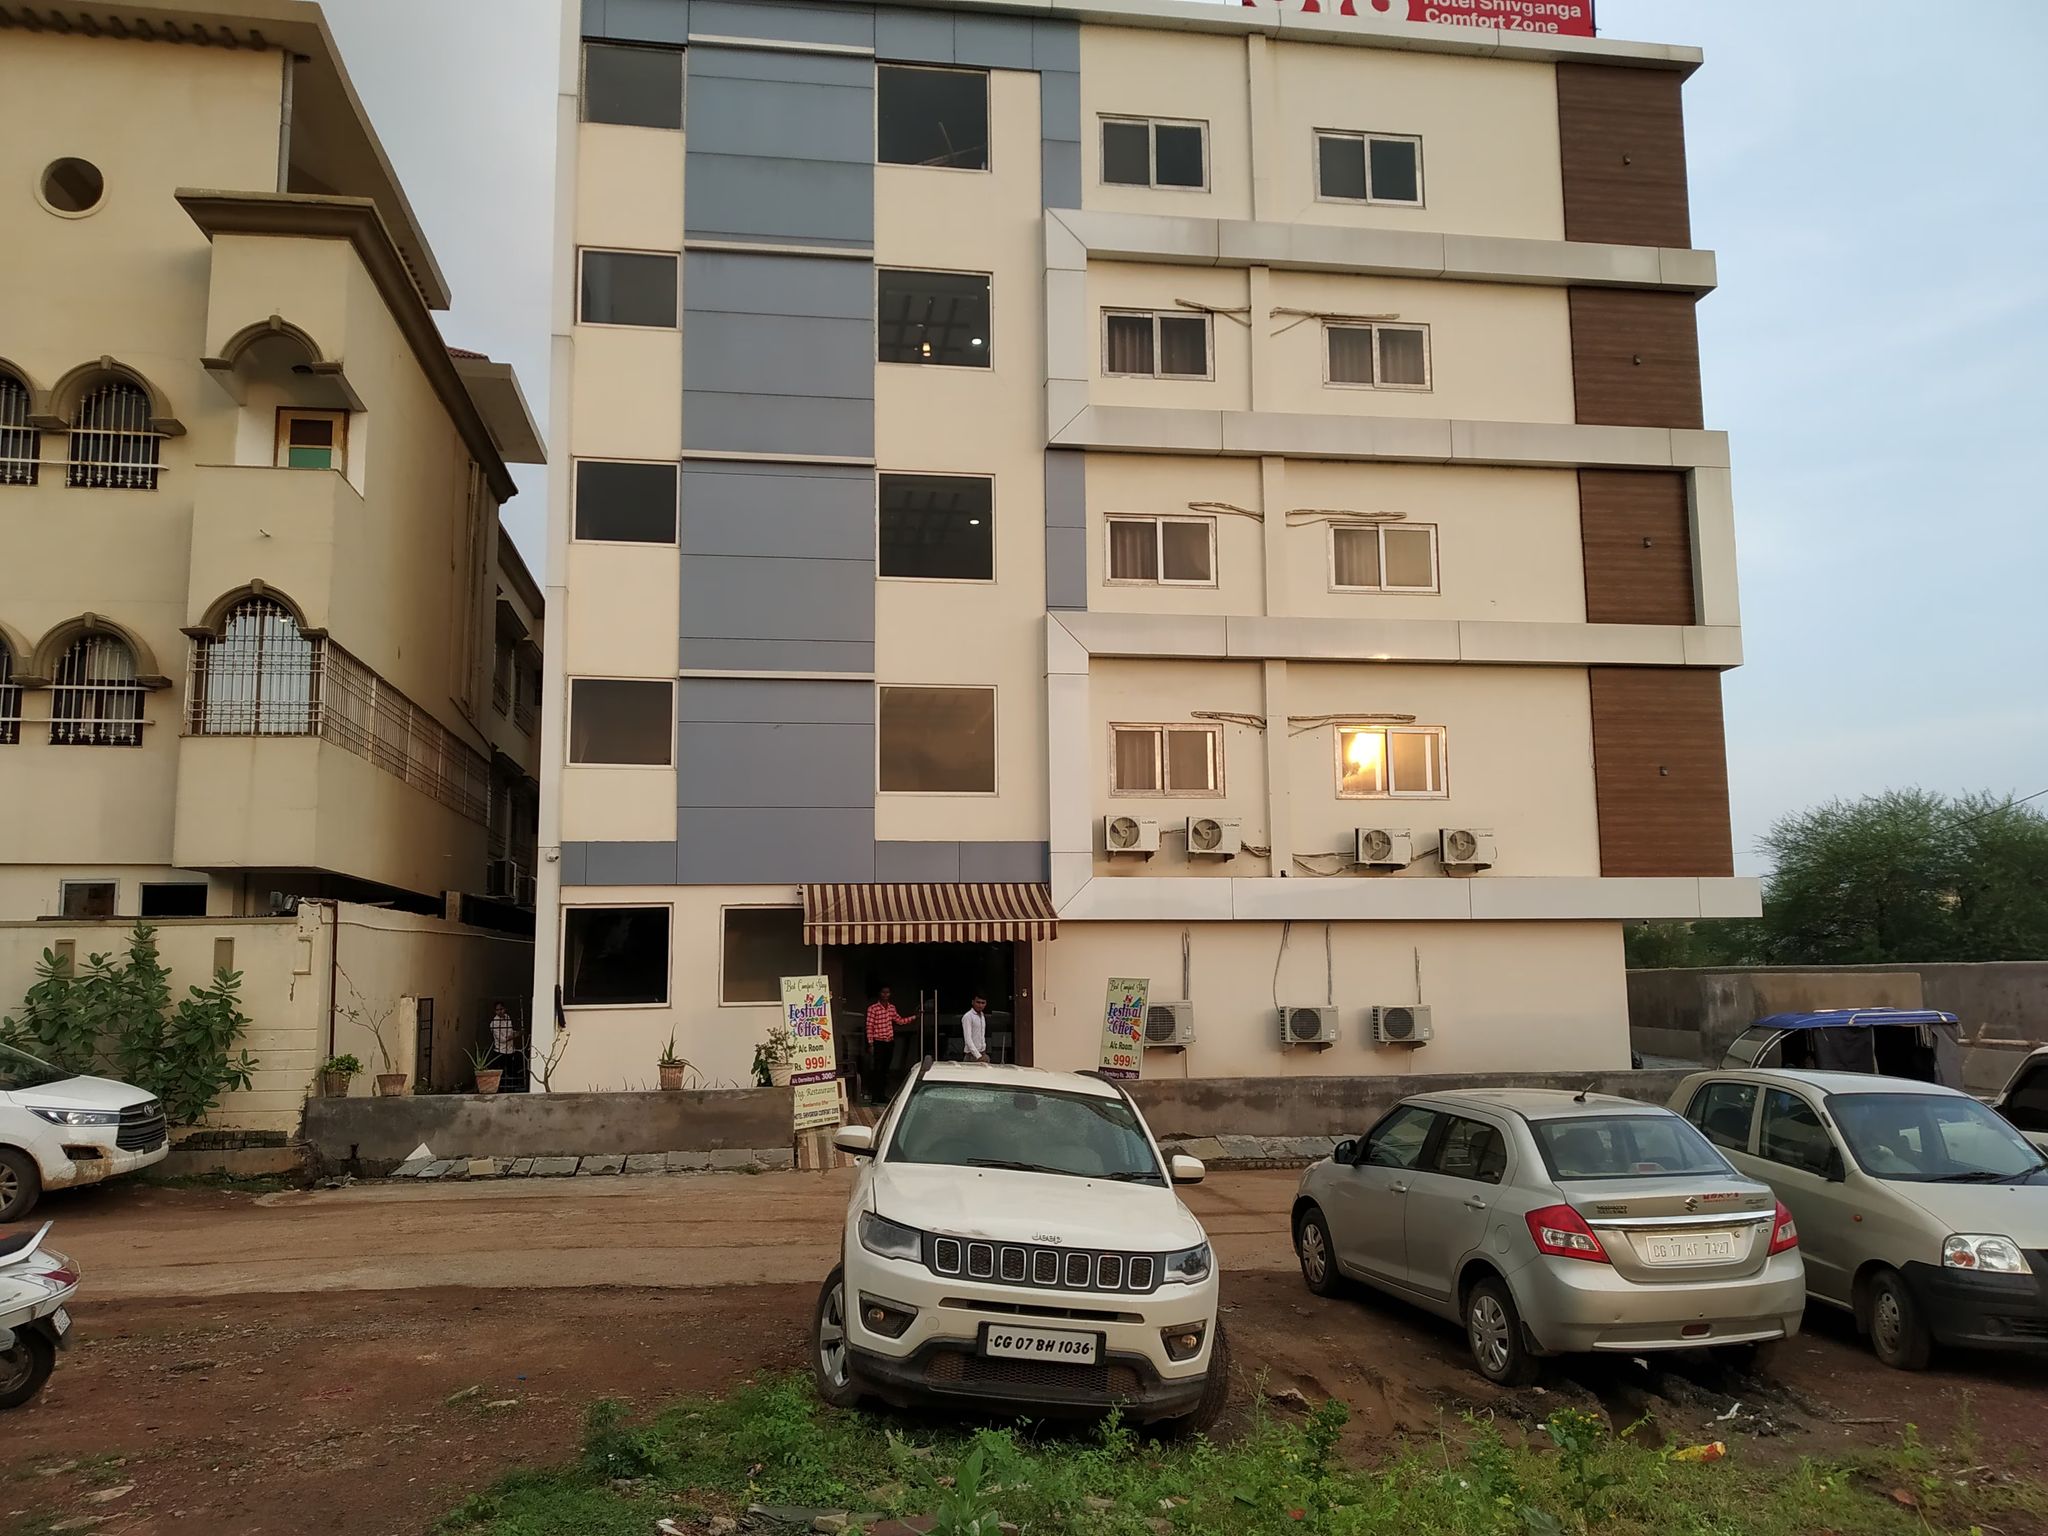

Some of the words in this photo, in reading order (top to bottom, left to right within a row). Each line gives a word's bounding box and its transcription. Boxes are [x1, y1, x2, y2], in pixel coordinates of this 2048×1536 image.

[1480, 0, 1581, 20] Shivganga
[1425, 8, 1506, 29] Comfort
[1510, 15, 1558, 34] Zone
[788, 1002, 827, 1019] Festival
[1108, 1002, 1143, 1018] Festival
[796, 1021, 822, 1038] Offer
[1112, 1019, 1134, 1036] Offer
[809, 1043, 825, 1052] Room
[1118, 1041, 1133, 1050] Room
[794, 1062, 804, 1072] Rs.
[1103, 1056, 1112, 1065] Rs.
[1030, 1231, 1063, 1245] Jeep
[1653, 1244, 1667, 1258] CG
[1670, 1243, 1681, 1257] 17
[994, 1335, 1013, 1349] CG
[1015, 1337, 1034, 1350] 07
[1036, 1339, 1056, 1352] BH
[1058, 1341, 1090, 1355] 1036
